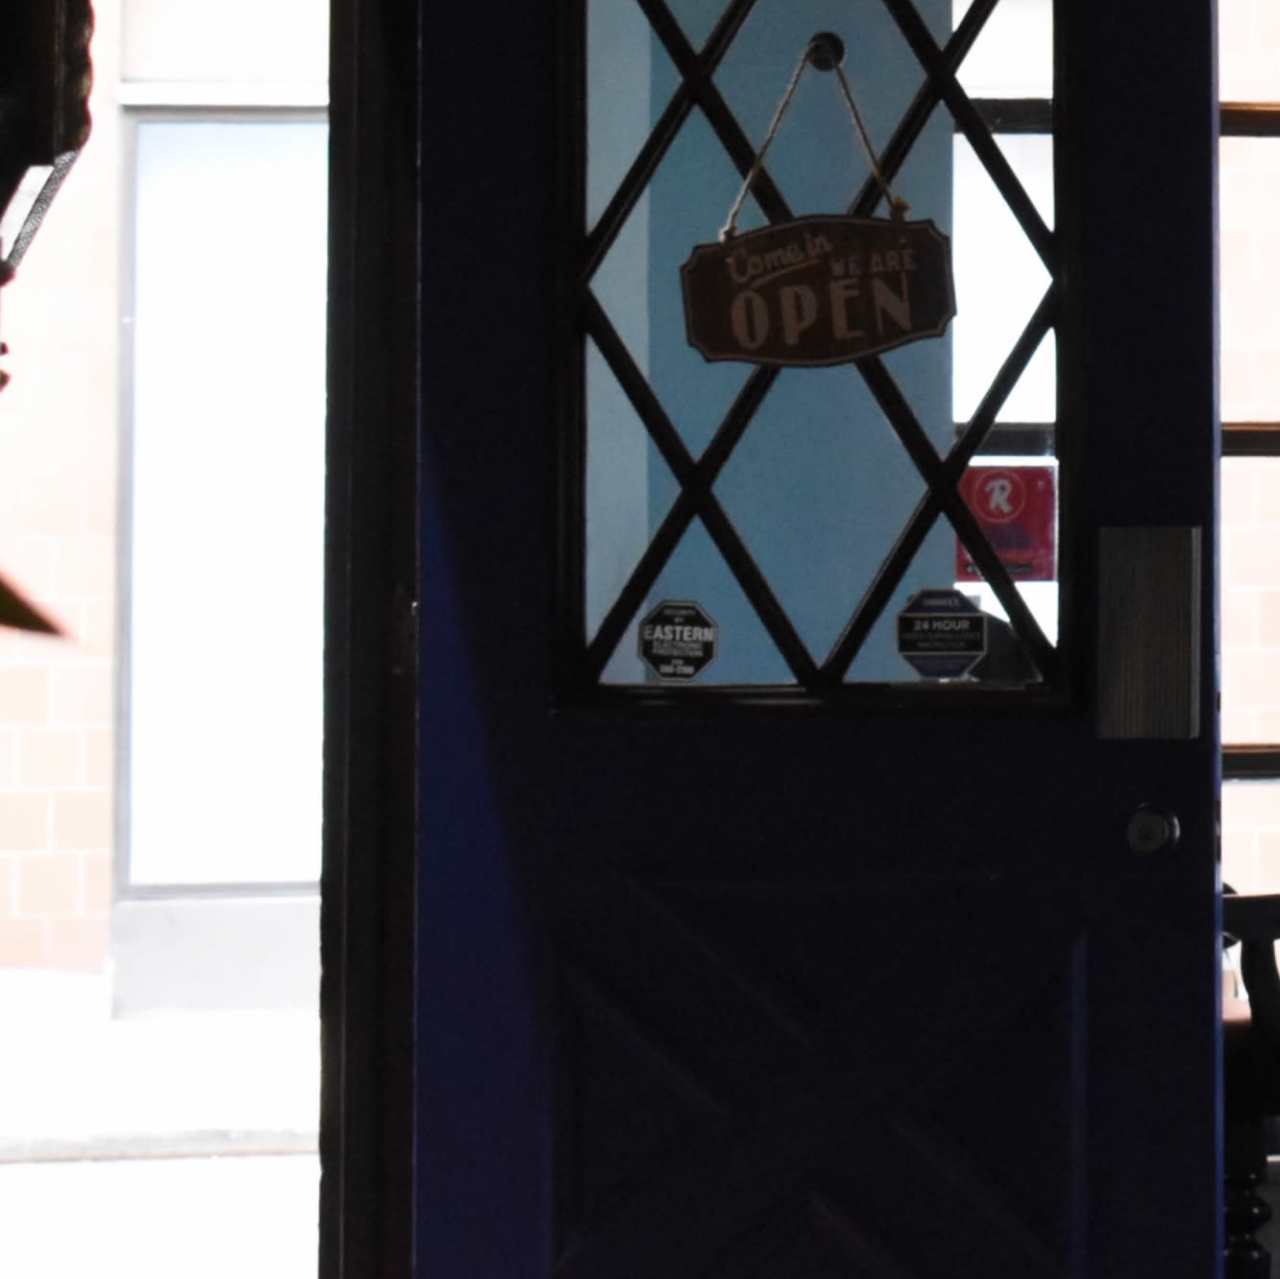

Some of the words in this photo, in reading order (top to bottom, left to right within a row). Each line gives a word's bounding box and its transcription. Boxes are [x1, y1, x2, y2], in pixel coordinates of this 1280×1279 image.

[870, 248, 916, 274] ARE
[731, 272, 913, 351] OPEN
[644, 625, 713, 641] EASTERN
